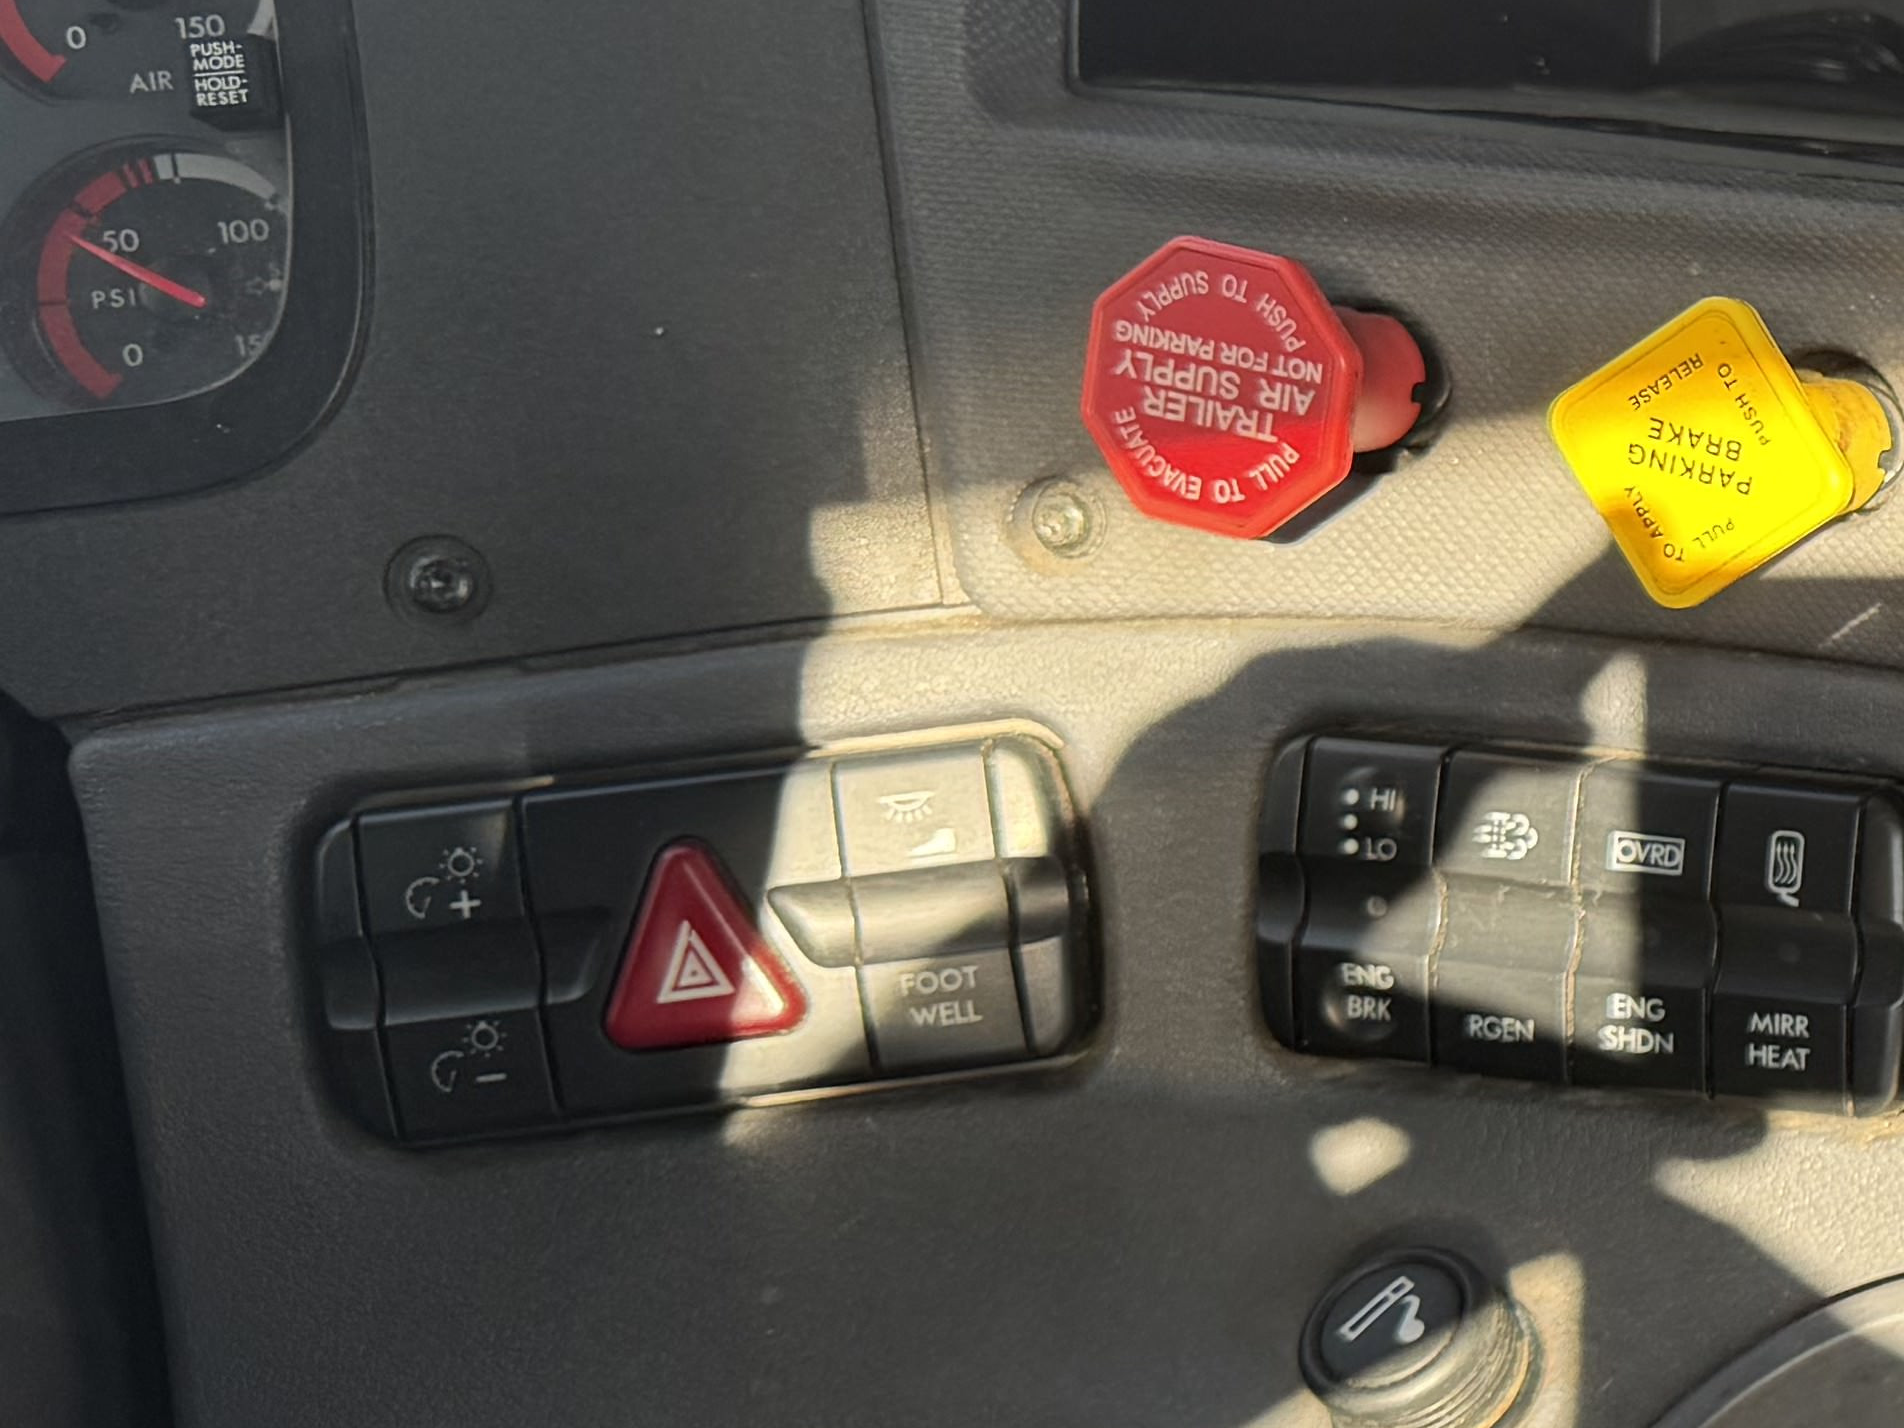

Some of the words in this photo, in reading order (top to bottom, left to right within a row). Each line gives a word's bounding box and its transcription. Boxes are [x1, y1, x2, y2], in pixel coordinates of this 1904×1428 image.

[66, 25, 87, 50] 0
[175, 14, 226, 40] 150
[190, 40, 242, 57] PUSH-
[193, 54, 245, 71] MODE
[129, 71, 174, 94] AIR
[194, 76, 248, 92] HOLD-
[196, 89, 249, 107] RESET
[102, 228, 140, 253] 50
[217, 218, 269, 244] 100
[91, 286, 136, 309] PSI
[1136, 270, 1209, 322] SUPPLY
[1221, 274, 1248, 304] TO
[1256, 292, 1307, 353] PUSH
[1115, 319, 1215, 360] PARKING
[122, 343, 143, 367] 0
[1220, 343, 1269, 371] FOR
[1272, 355, 1323, 384] NOT
[1114, 349, 1241, 400] SUPPLY
[1628, 352, 1704, 411] RELEASE
[1717, 363, 1738, 391] TO
[1258, 378, 1316, 416] AIR
[1142, 385, 1278, 444] TRAILER
[1735, 392, 1772, 446] PUSH
[1115, 406, 1202, 501] EVACUATE
[1648, 417, 1742, 462] BRAKE
[1248, 442, 1301, 490] PULL
[1628, 443, 1753, 496] PARKING
[1212, 478, 1246, 504] TO
[1624, 485, 1664, 538] APPLY
[1692, 518, 1735, 549] PULL
[1663, 543, 1685, 562] TO
[1369, 787, 1397, 810] HI
[1362, 836, 1397, 861] LO
[1616, 837, 1681, 868] OVRD
[899, 964, 979, 997] FOOT
[1342, 963, 1395, 991] ENG
[908, 999, 984, 1028] WELL
[1347, 995, 1392, 1023] BRK
[1607, 993, 1666, 1023] ENG
[1466, 1013, 1535, 1044] RGEN
[1599, 1024, 1674, 1055] SHDN
[1748, 1012, 1810, 1039] MIRR
[1748, 1043, 1811, 1071] HEAT
